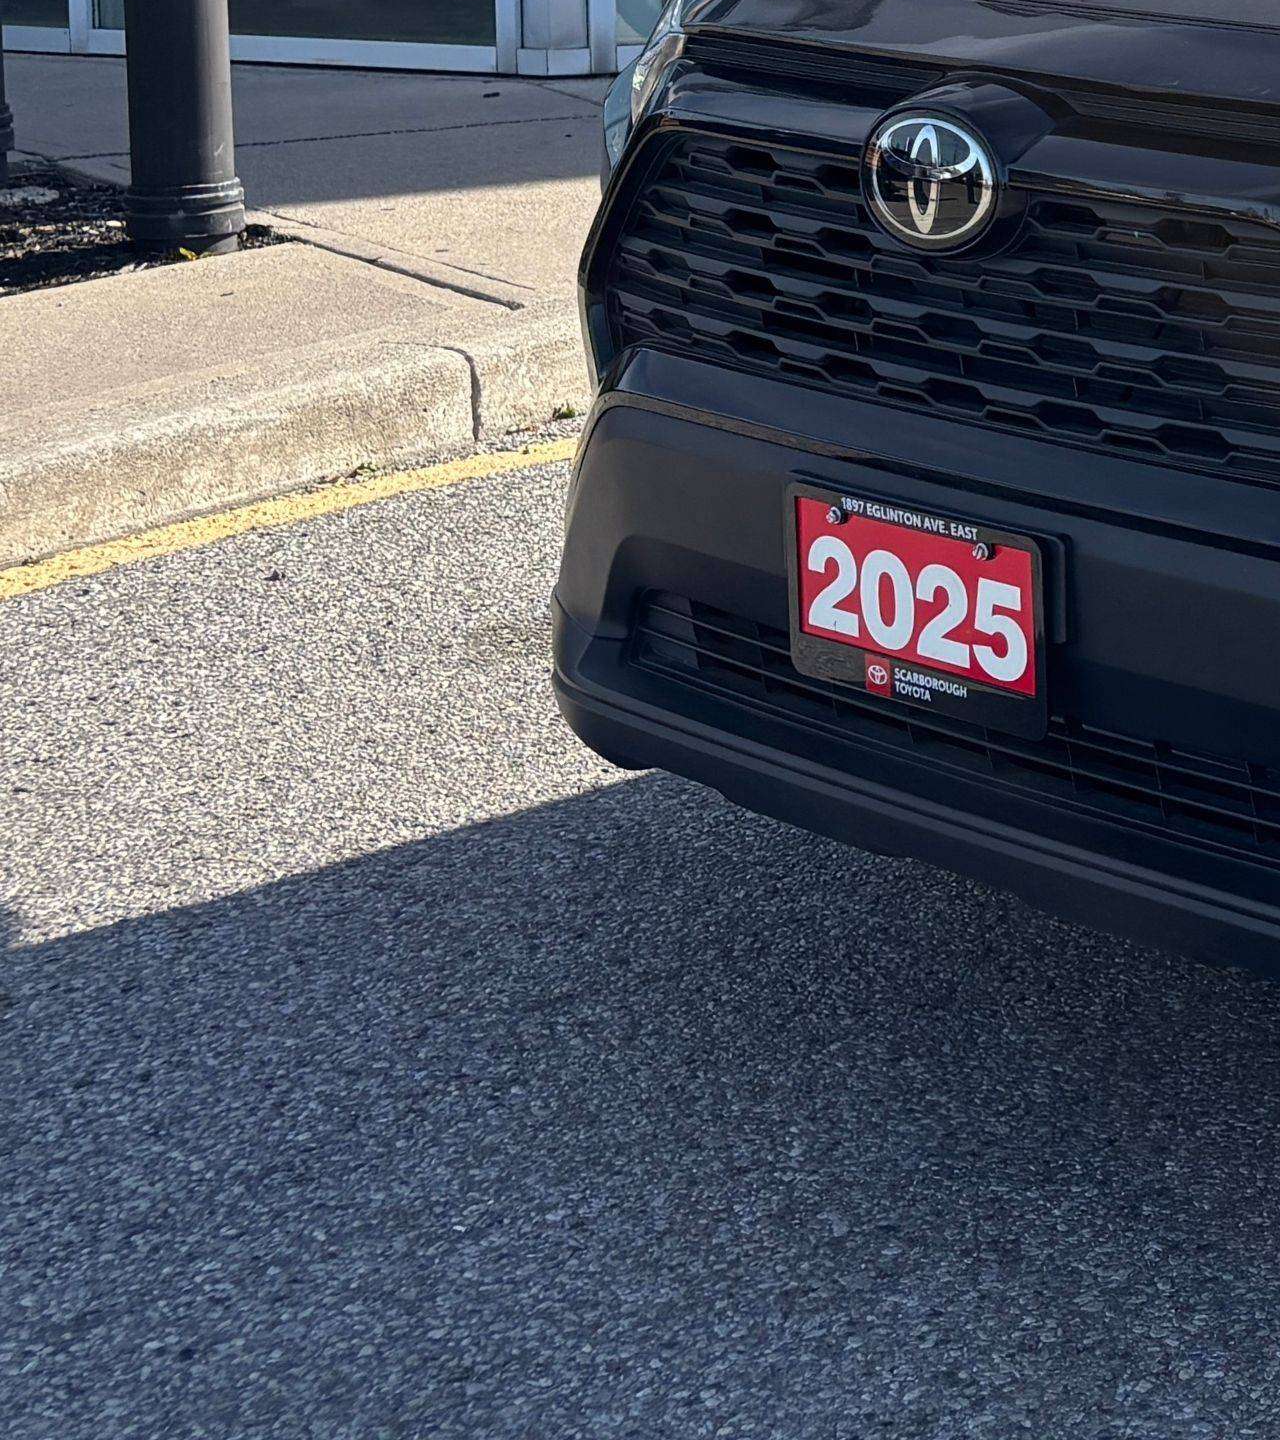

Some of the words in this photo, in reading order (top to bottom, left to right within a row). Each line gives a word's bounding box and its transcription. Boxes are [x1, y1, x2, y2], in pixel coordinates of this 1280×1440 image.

[841, 497, 864, 514] 1897
[866, 502, 921, 527] EGLINTON
[923, 517, 948, 534] AVE.
[950, 523, 977, 540] EAST
[808, 535, 1028, 682] 2025
[894, 668, 968, 698] SCARBOROUGH
[895, 681, 931, 702] TOYOTA
